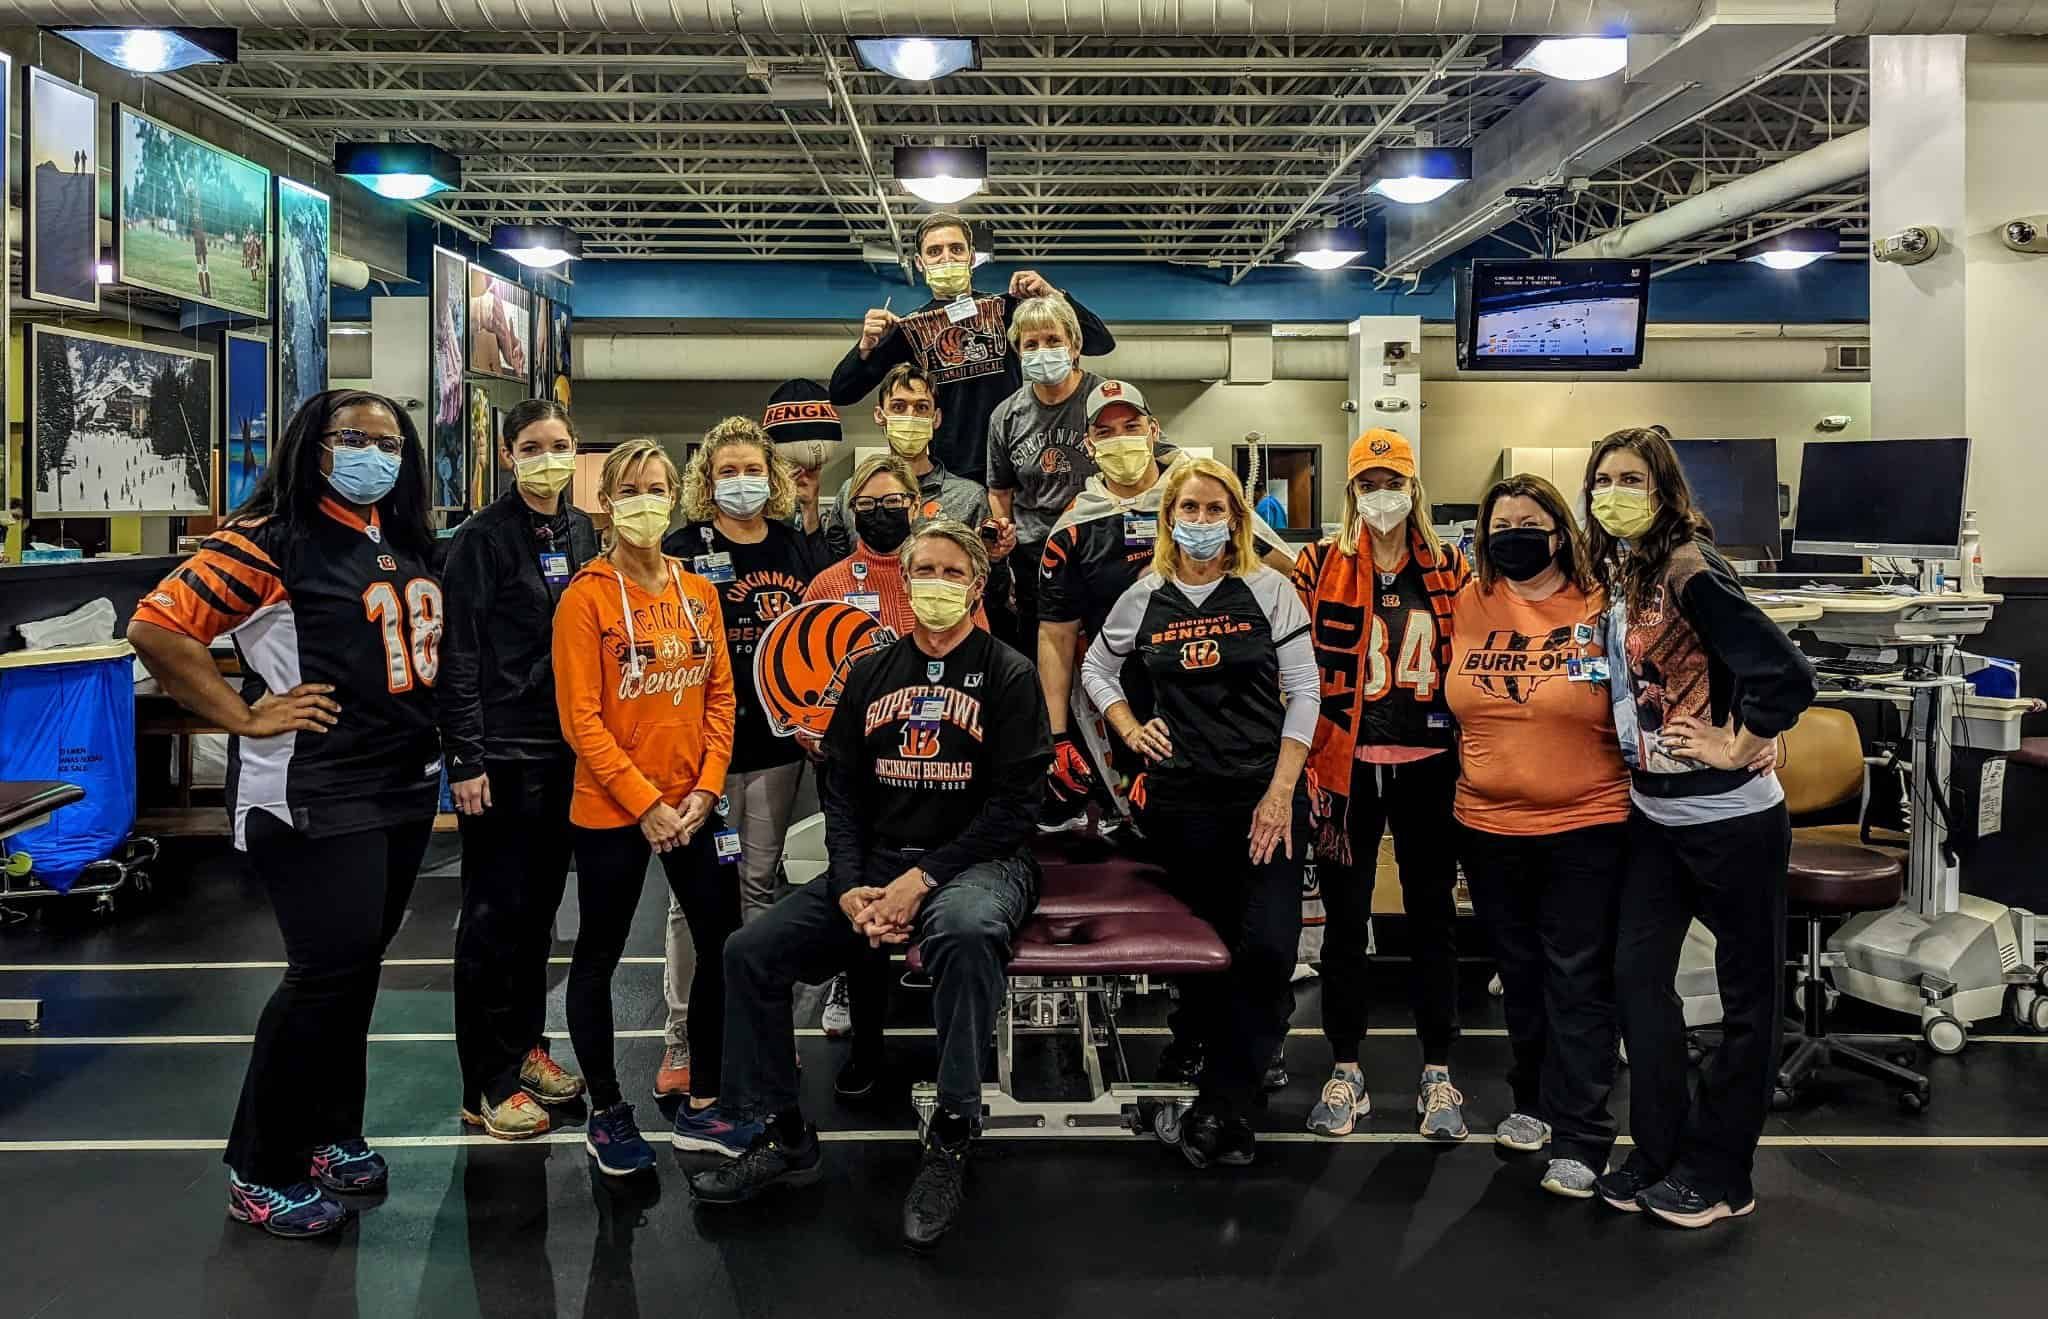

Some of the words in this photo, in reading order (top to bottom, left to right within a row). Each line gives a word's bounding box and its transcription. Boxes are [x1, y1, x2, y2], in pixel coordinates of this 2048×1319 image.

[727, 570, 808, 603] CINCINNATI
[1151, 622, 1252, 645] BENGALS
[1168, 615, 1230, 630] CINCINNATI
[362, 577, 444, 695] 18
[922, 761, 973, 781] BENGALS
